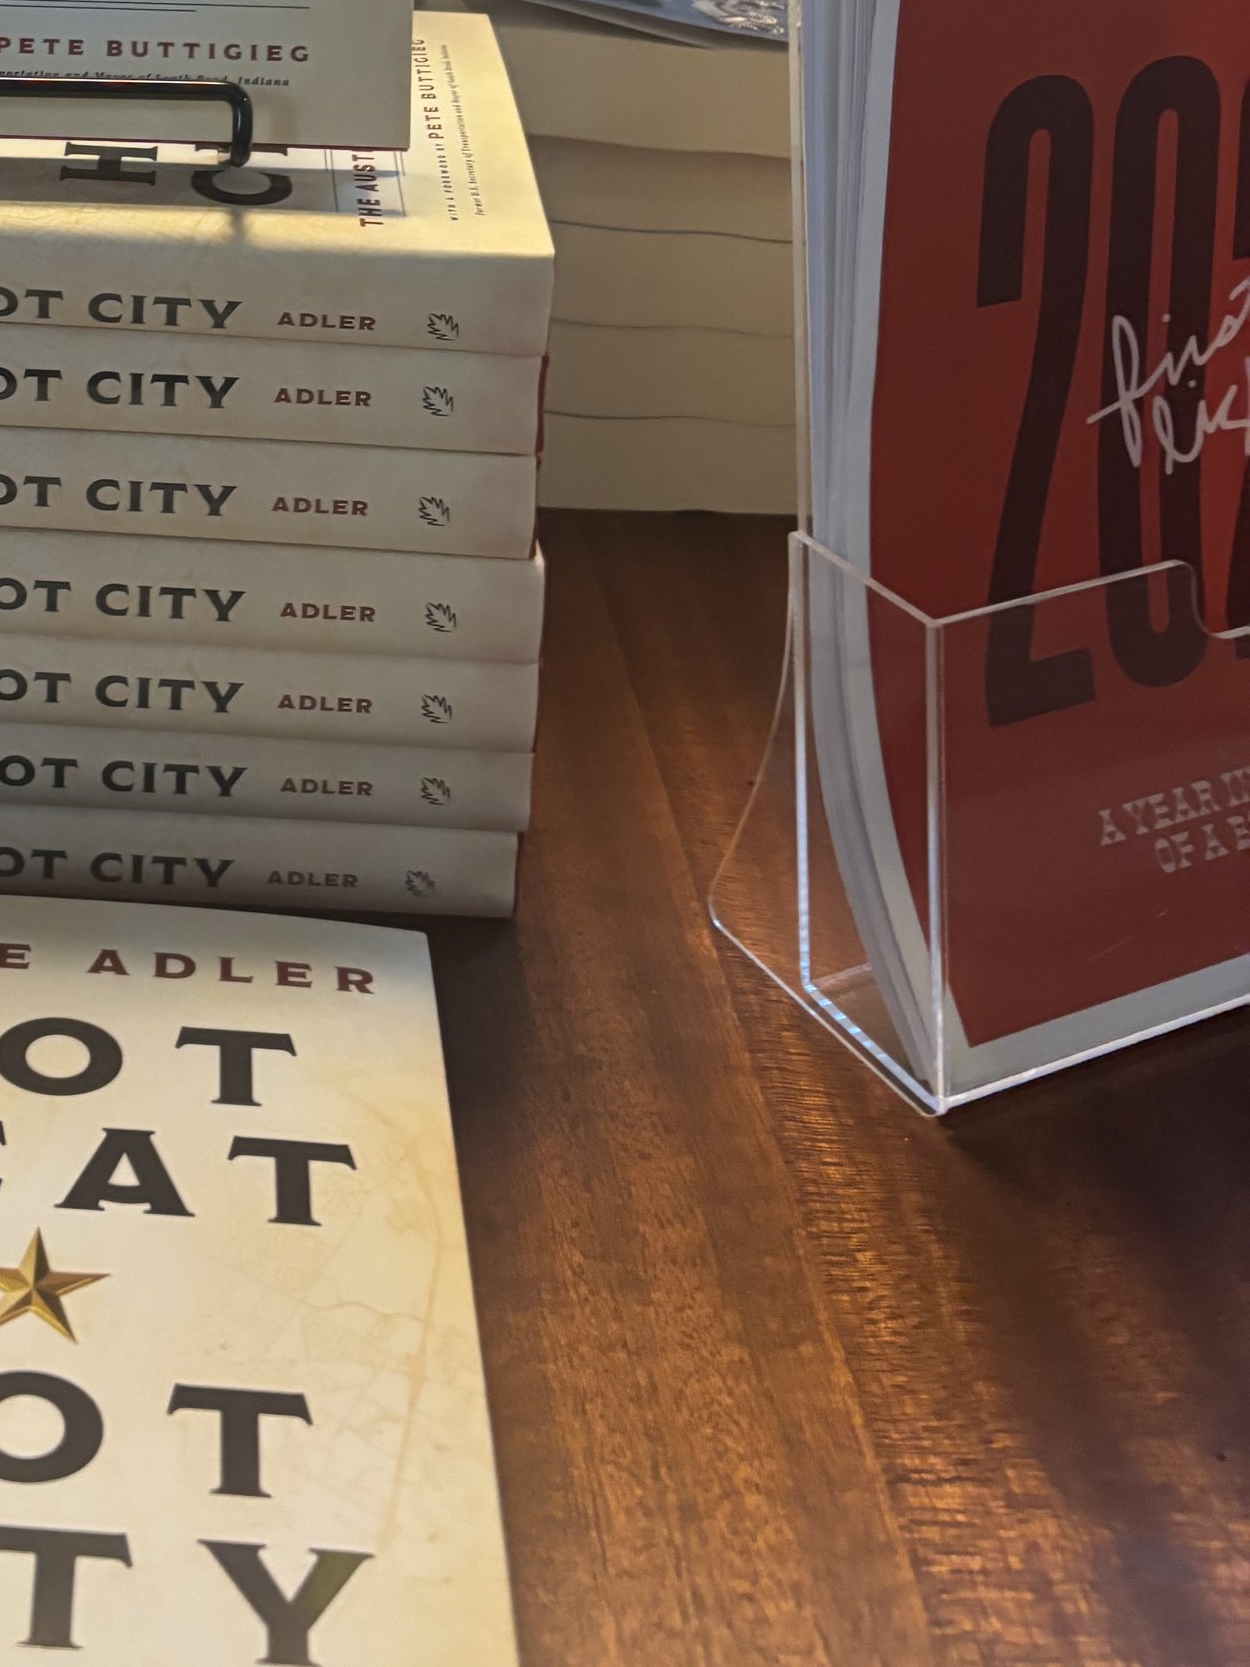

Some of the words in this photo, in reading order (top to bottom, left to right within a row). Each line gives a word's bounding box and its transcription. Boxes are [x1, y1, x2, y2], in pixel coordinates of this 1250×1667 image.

[106, 40, 310, 62] BUTTIGIEG
[412, 39, 437, 99] BUTTIGIEG
[238, 76, 290, 86] Indiana
[424, 106, 445, 139] PETE
[351, 149, 379, 192] AUST
[357, 198, 384, 227] THE
[88, 293, 243, 329] CITY
[277, 312, 376, 331] ADLER
[86, 371, 240, 409] CITY
[275, 388, 372, 406] ADLER
[977, 55, 1250, 727] 20
[86, 479, 238, 516] CITY
[272, 497, 368, 516] ADLER
[95, 583, 246, 622] CITY
[280, 602, 375, 622] ADLER
[95, 675, 246, 713] CITY
[278, 694, 372, 714] ADLER
[102, 760, 248, 797] CITY
[280, 778, 372, 796] ADLER
[1099, 809, 1126, 846] A
[1122, 780, 1221, 835] YEAR
[1154, 831, 1194, 873] OF
[1201, 823, 1229, 860] A
[90, 852, 235, 888] CITY
[267, 870, 358, 888] ADLER
[87, 948, 376, 996] ADLER
